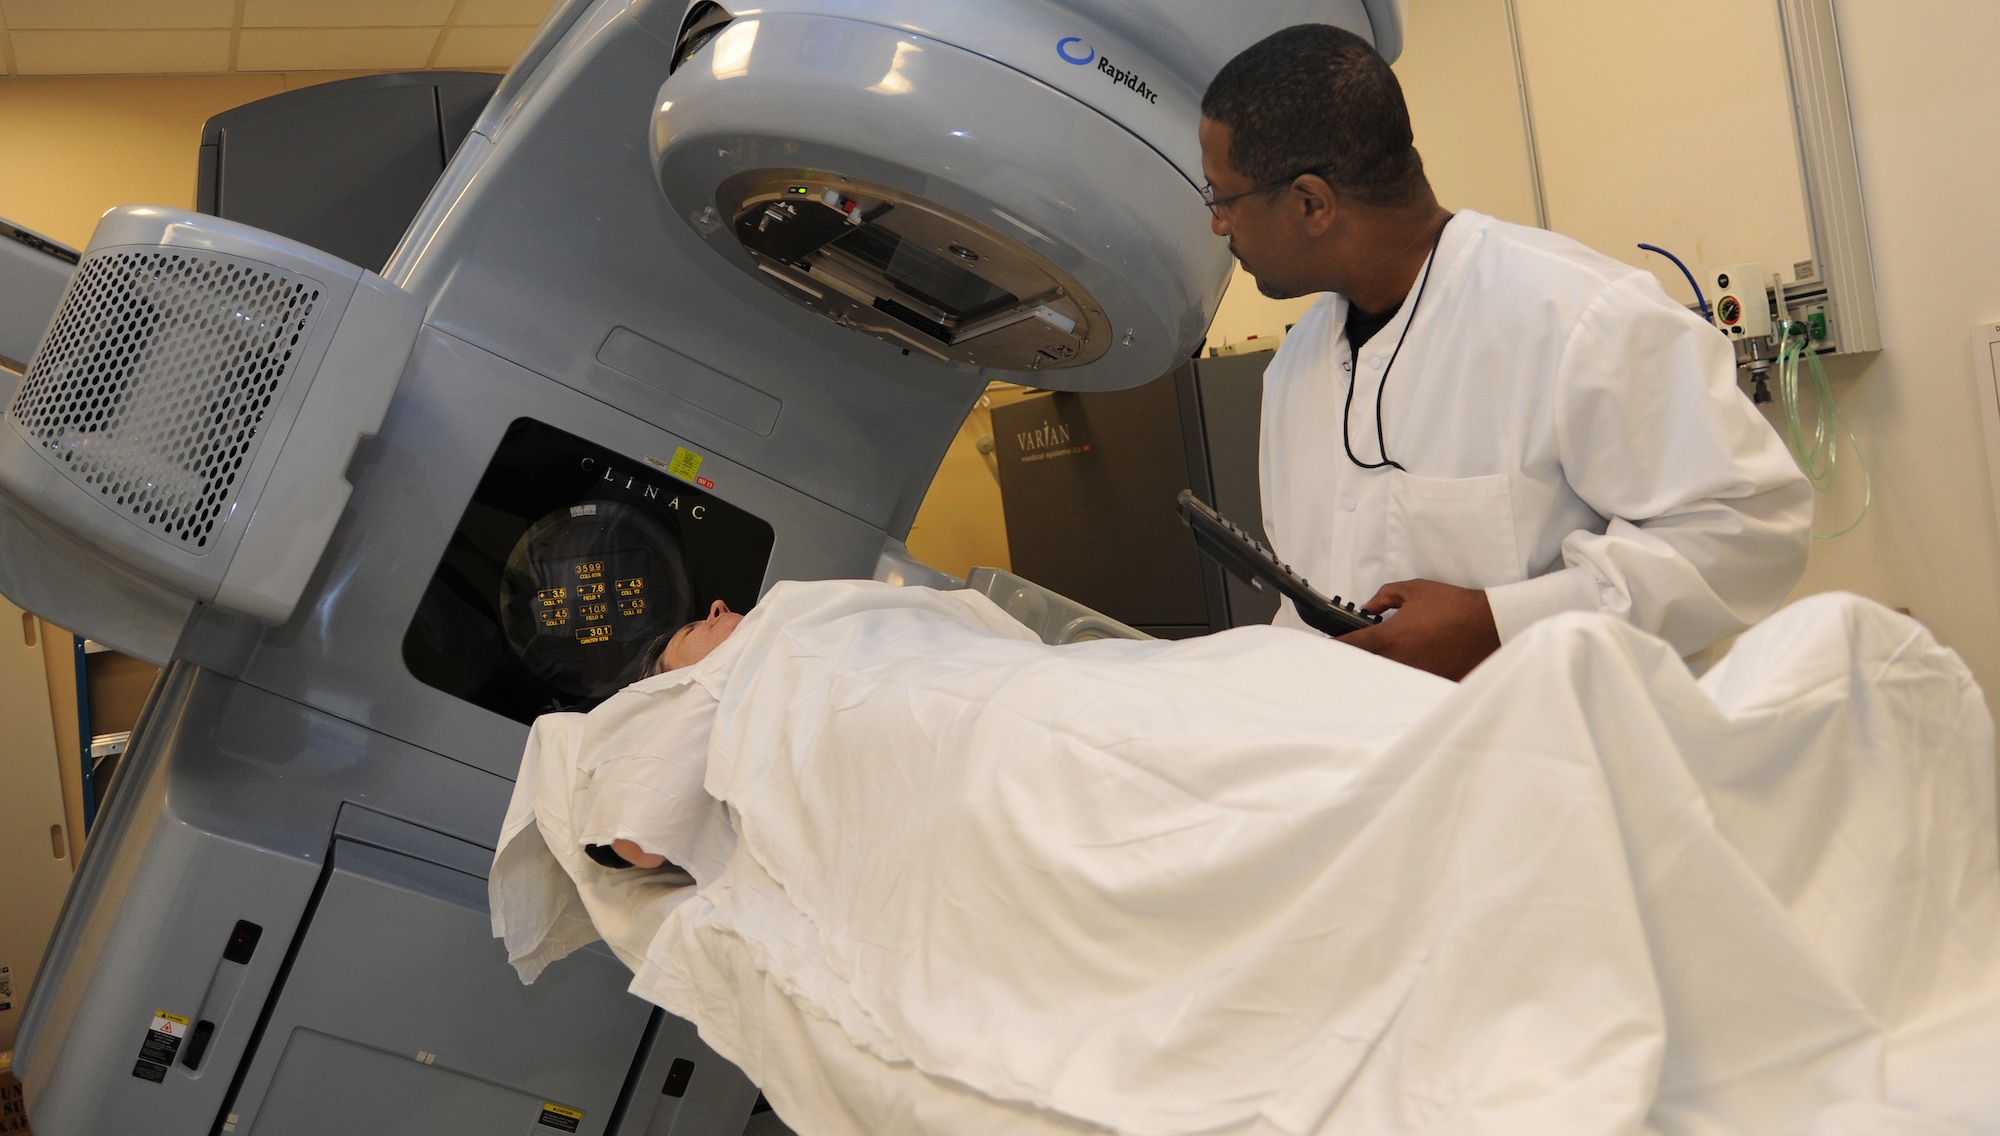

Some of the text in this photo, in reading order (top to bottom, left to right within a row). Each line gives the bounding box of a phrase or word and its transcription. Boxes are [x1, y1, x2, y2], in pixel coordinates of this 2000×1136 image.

[1097, 56, 1158, 104] RapidArc
[1017, 420, 1070, 451] VARIAN
[552, 589, 565, 598] 3.5
[591, 584, 604, 593] 7.8
